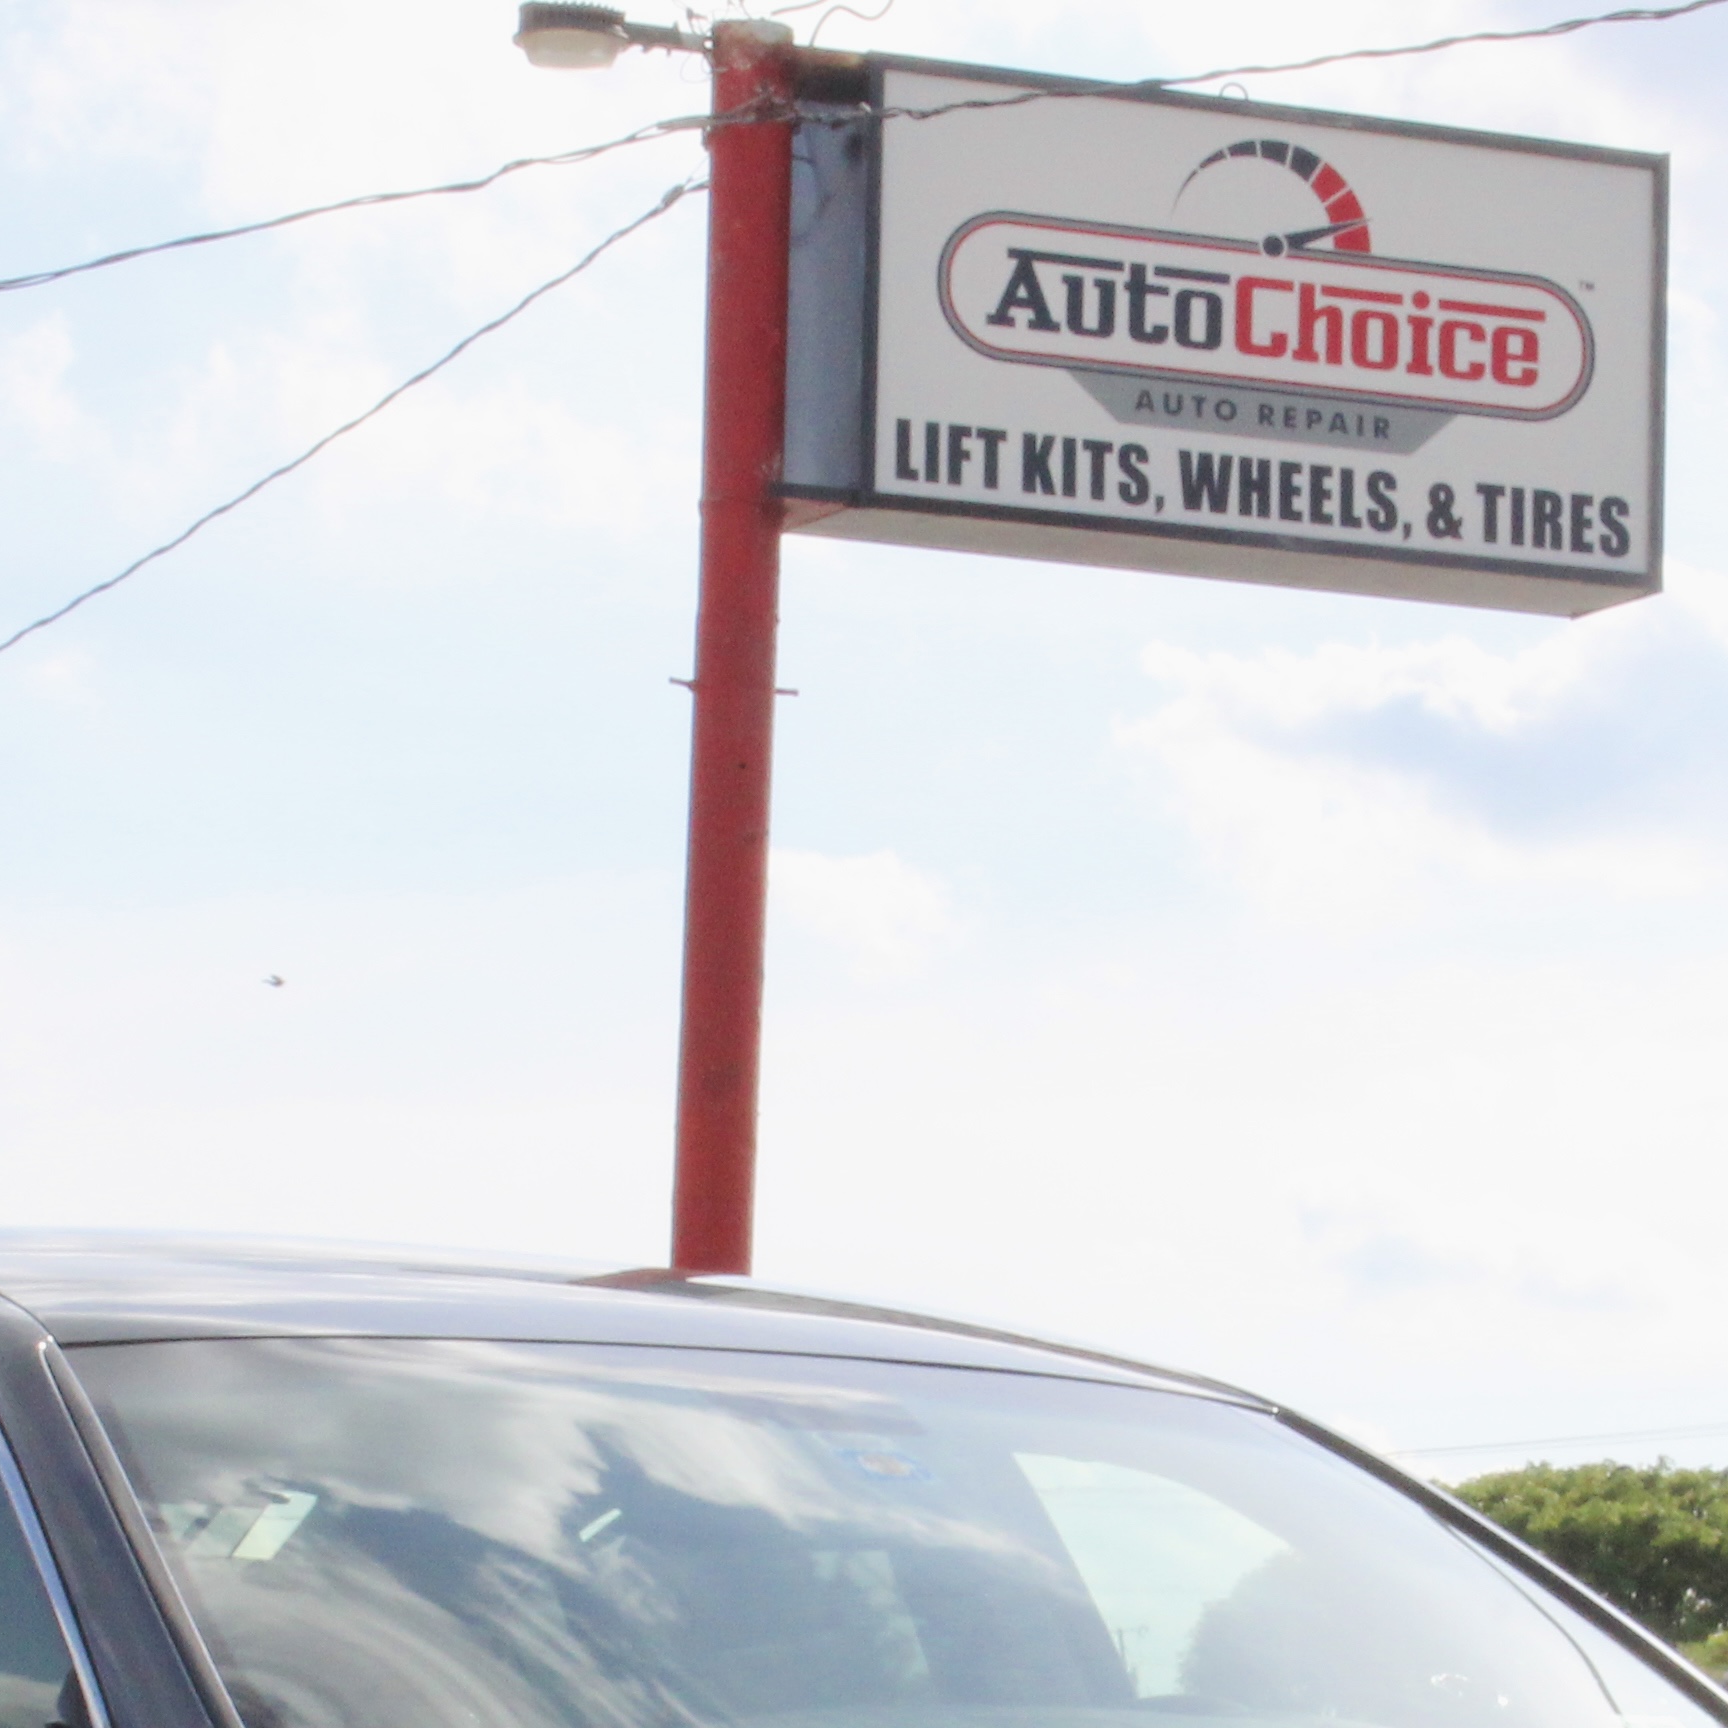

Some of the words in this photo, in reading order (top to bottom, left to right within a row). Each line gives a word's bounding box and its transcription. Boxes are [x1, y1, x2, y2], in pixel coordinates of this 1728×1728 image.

[1131, 386, 1239, 427] AUTO
[1255, 396, 1392, 442] REPAIR
[896, 419, 1007, 489] LIFT
[1022, 433, 1164, 513] KITS,
[1179, 450, 1412, 540] WHEELS,
[1427, 483, 1462, 540] &
[1477, 483, 1630, 558] TIRES
